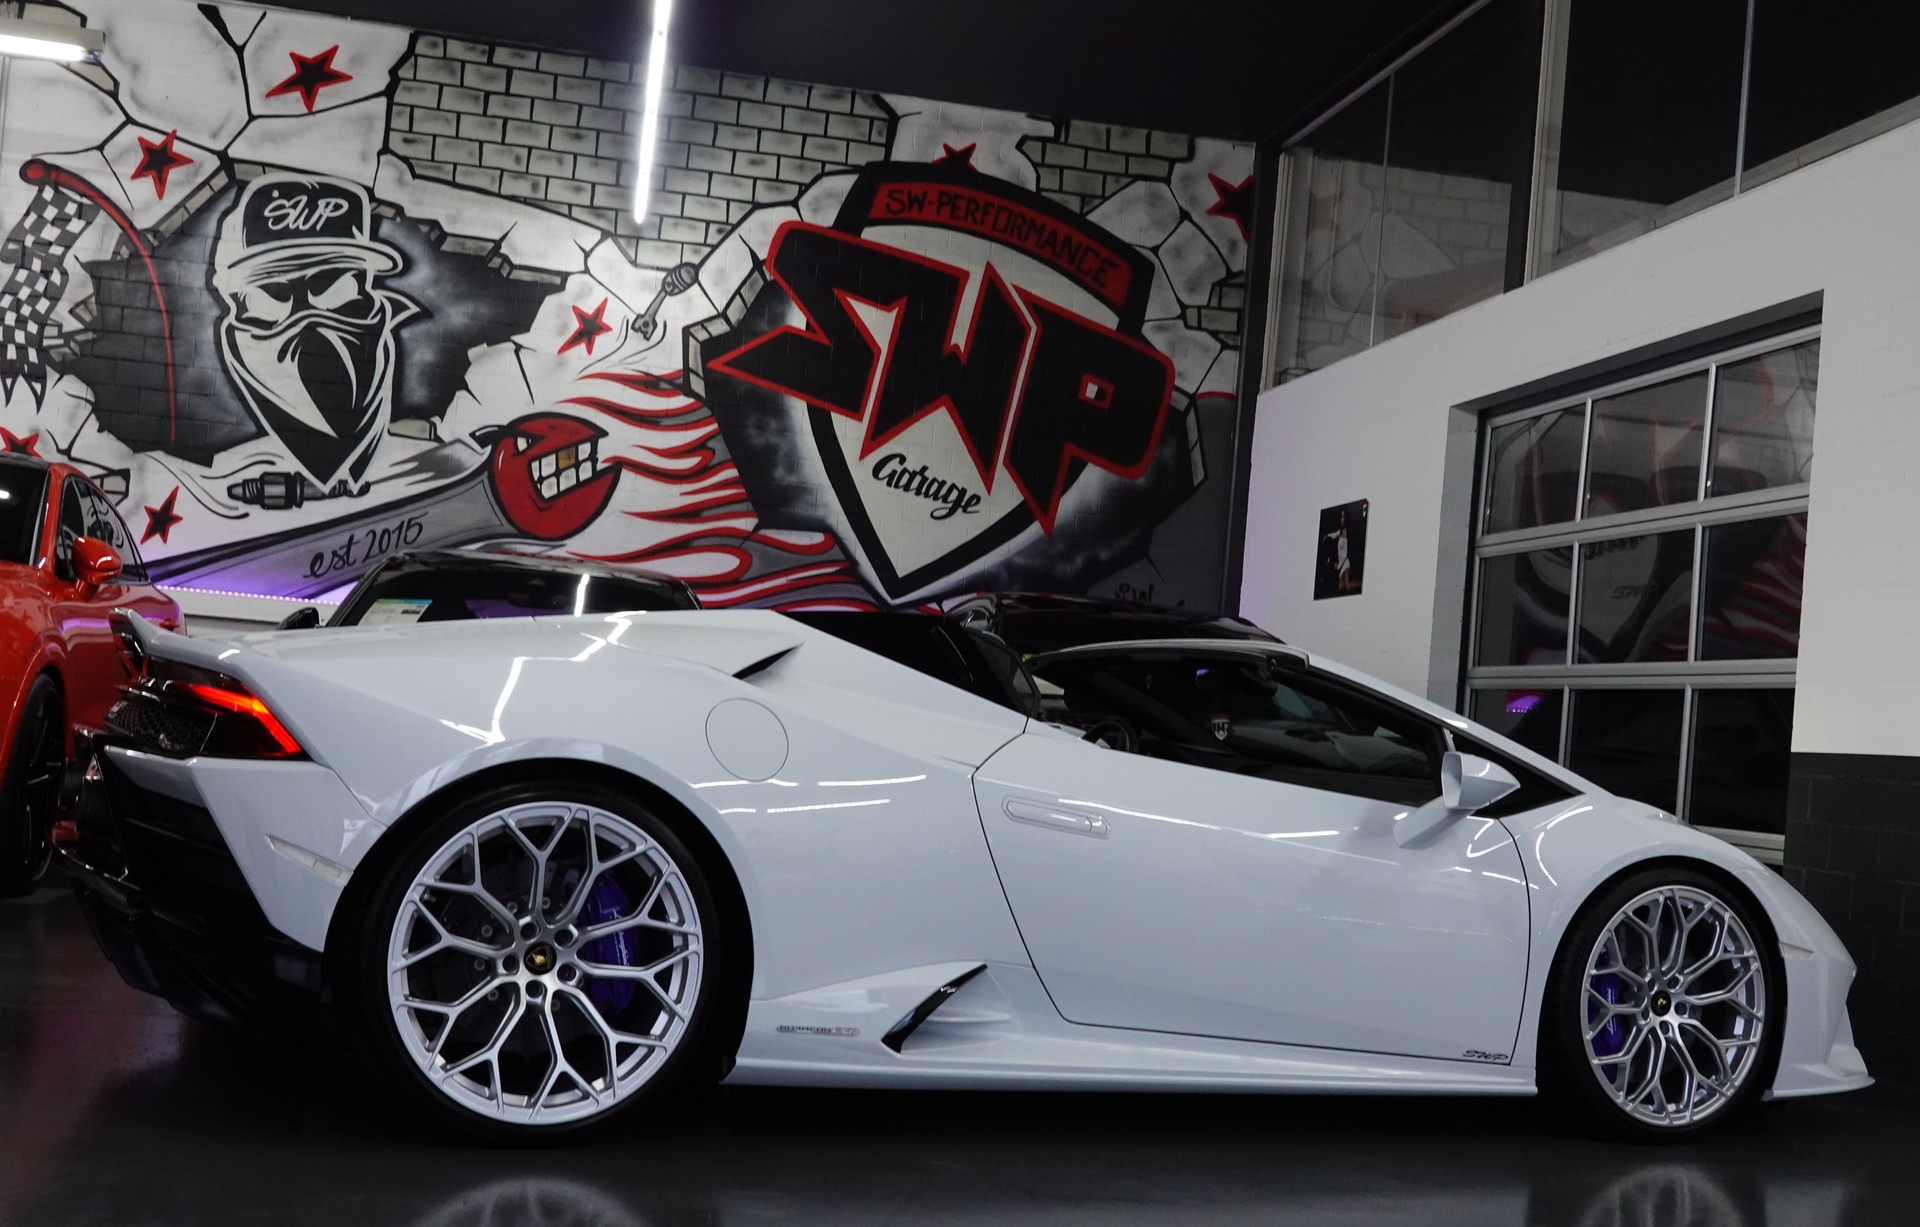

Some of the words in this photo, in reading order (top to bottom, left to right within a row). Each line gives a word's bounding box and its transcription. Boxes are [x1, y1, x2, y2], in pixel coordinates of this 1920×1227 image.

[263, 190, 349, 231] SWP
[884, 188, 1119, 289] SW-PERFORMANCE
[707, 221, 1176, 537] SWP
[871, 453, 982, 521] Garage
[302, 533, 361, 578] est
[362, 511, 430, 563] 2015
